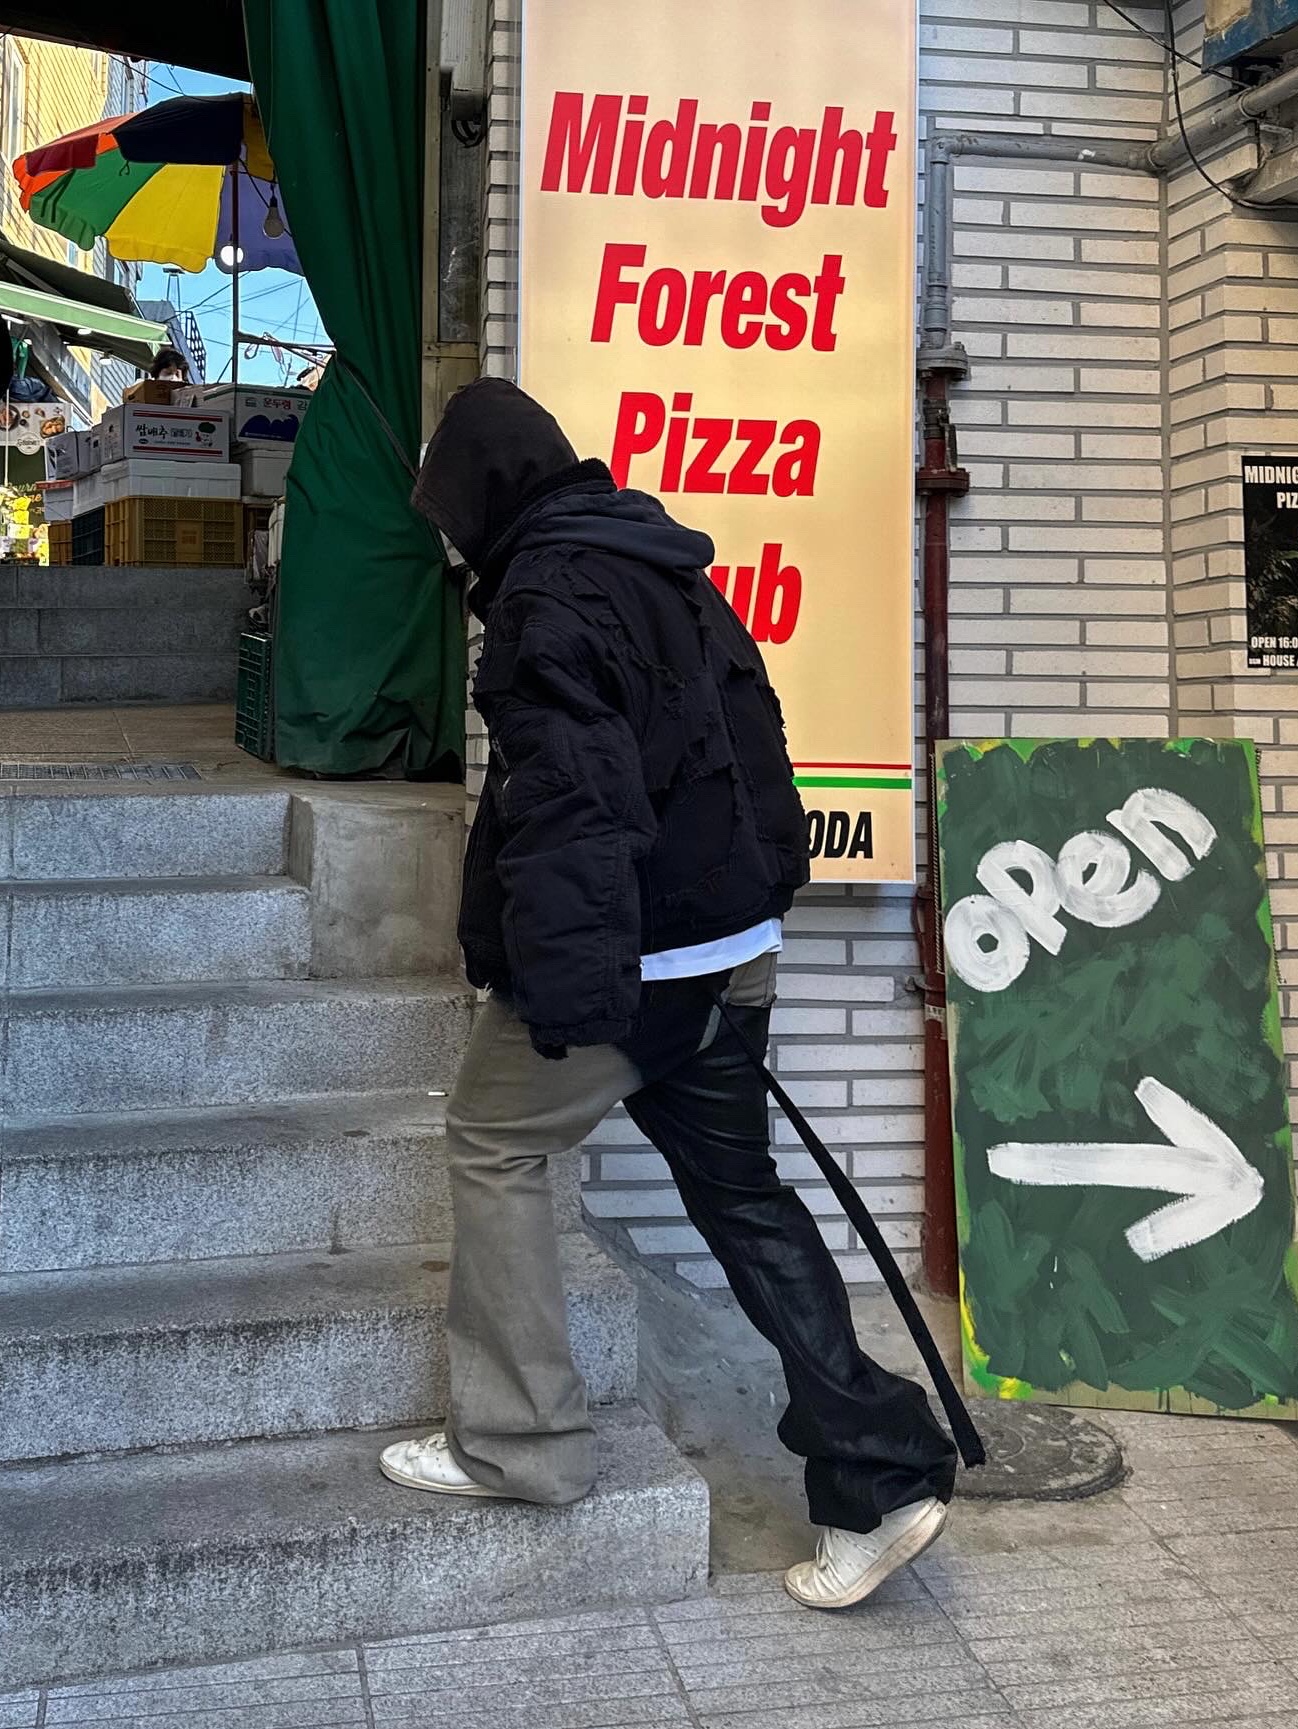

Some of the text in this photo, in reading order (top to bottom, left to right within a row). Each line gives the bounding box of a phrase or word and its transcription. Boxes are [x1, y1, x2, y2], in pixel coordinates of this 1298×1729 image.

[540, 91, 897, 228] Midnight
[590, 243, 846, 352] Forest
[609, 391, 821, 497] Pizza
[1276, 492, 1298, 509] PIZ
[1251, 636, 1277, 649] OPEN
[1263, 654, 1295, 667] HOUSE
[943, 788, 1217, 993] open
